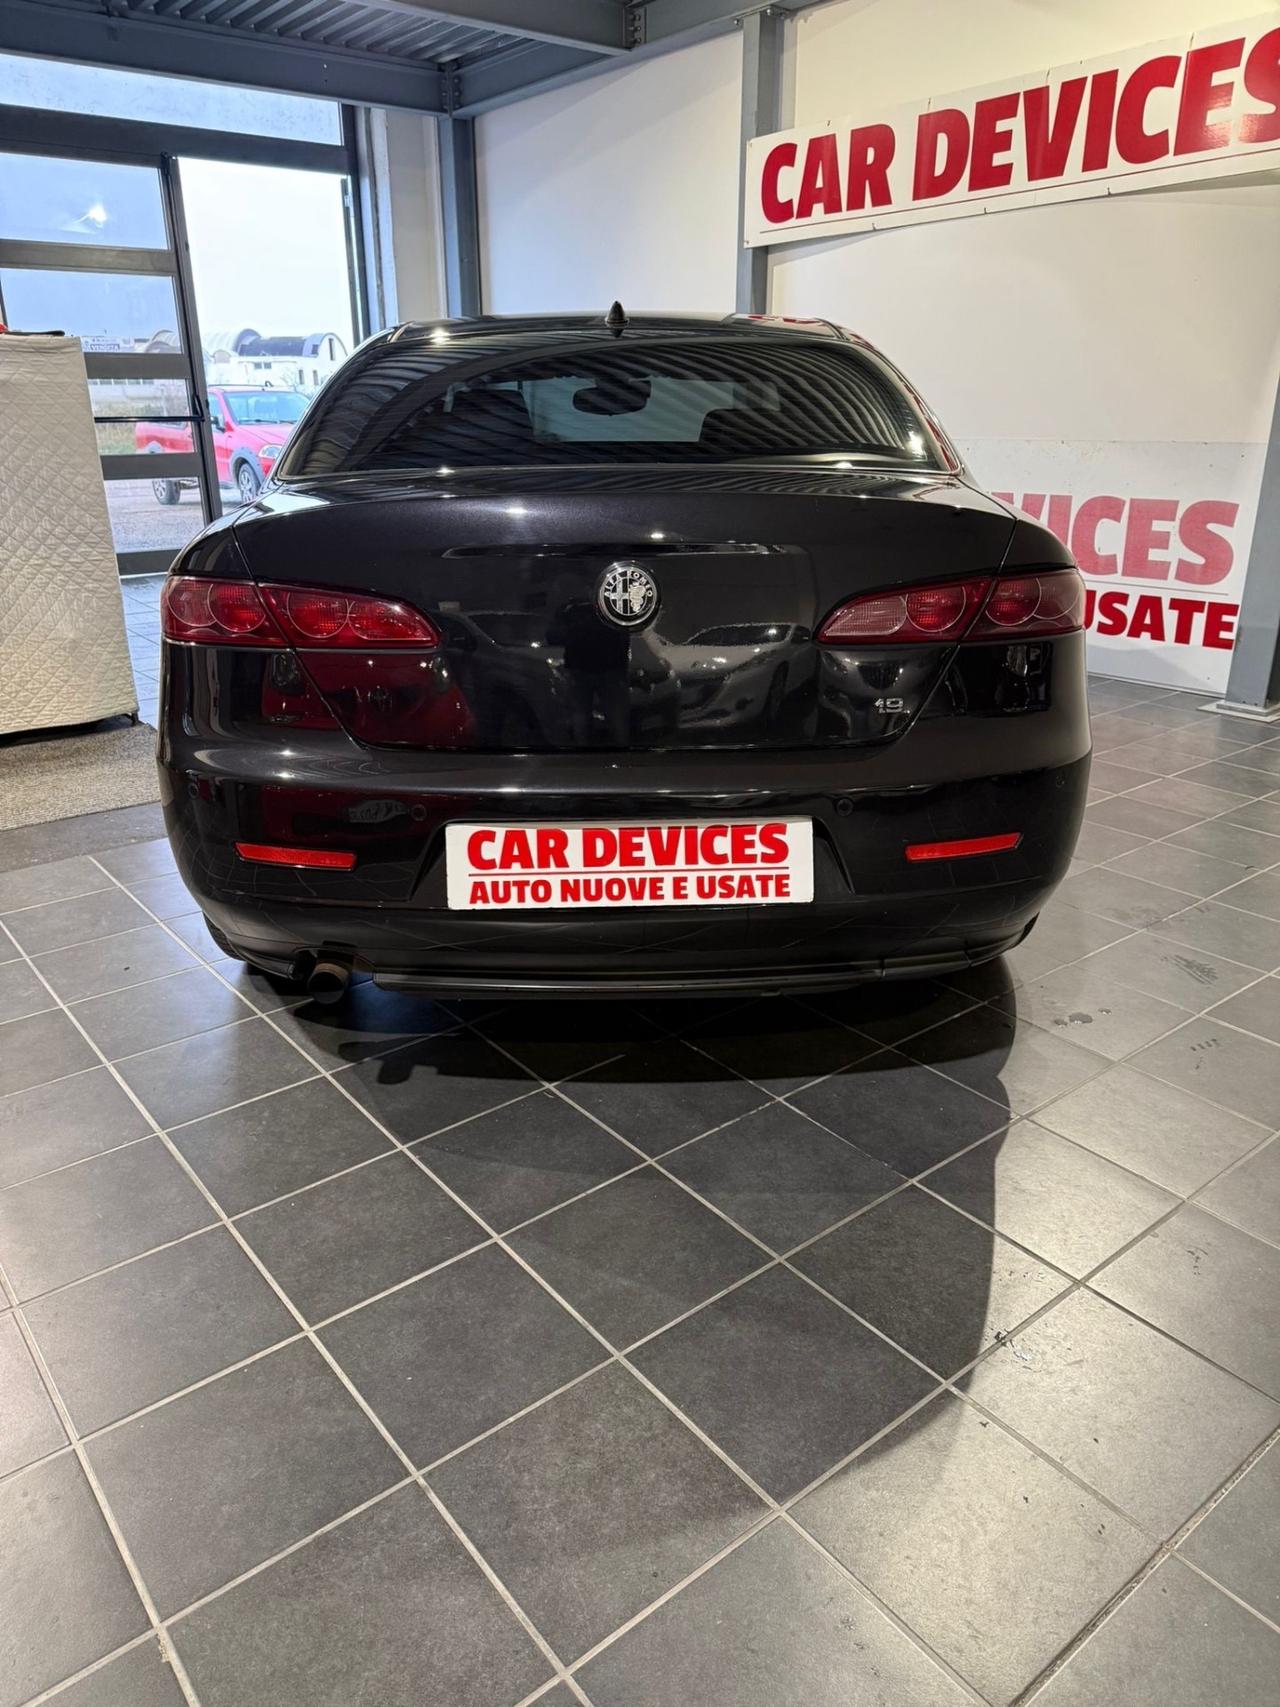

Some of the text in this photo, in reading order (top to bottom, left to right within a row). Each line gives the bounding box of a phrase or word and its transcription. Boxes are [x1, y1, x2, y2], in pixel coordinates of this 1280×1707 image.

[761, 123, 896, 224] CAR
[467, 823, 790, 870] CAR DEVICES
[469, 874, 791, 905] AUTO NUOVE E USATE
